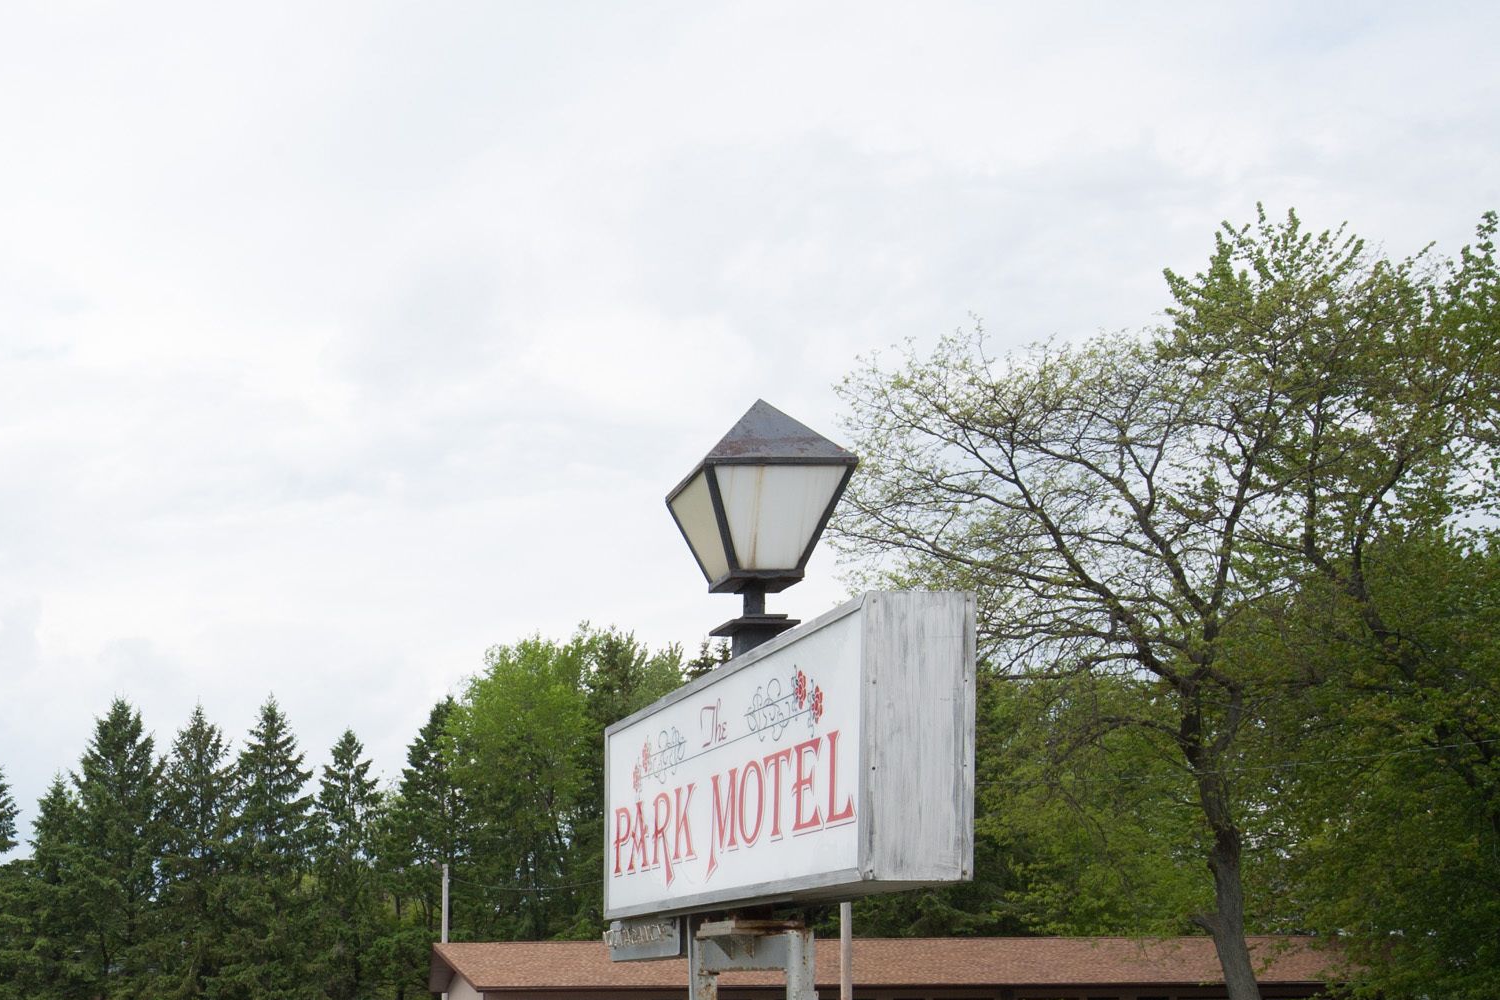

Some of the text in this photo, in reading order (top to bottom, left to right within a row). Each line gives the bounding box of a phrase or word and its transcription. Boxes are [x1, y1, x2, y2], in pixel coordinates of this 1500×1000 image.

[700, 698, 728, 748] The
[614, 730, 857, 889] PARK MOTEL
